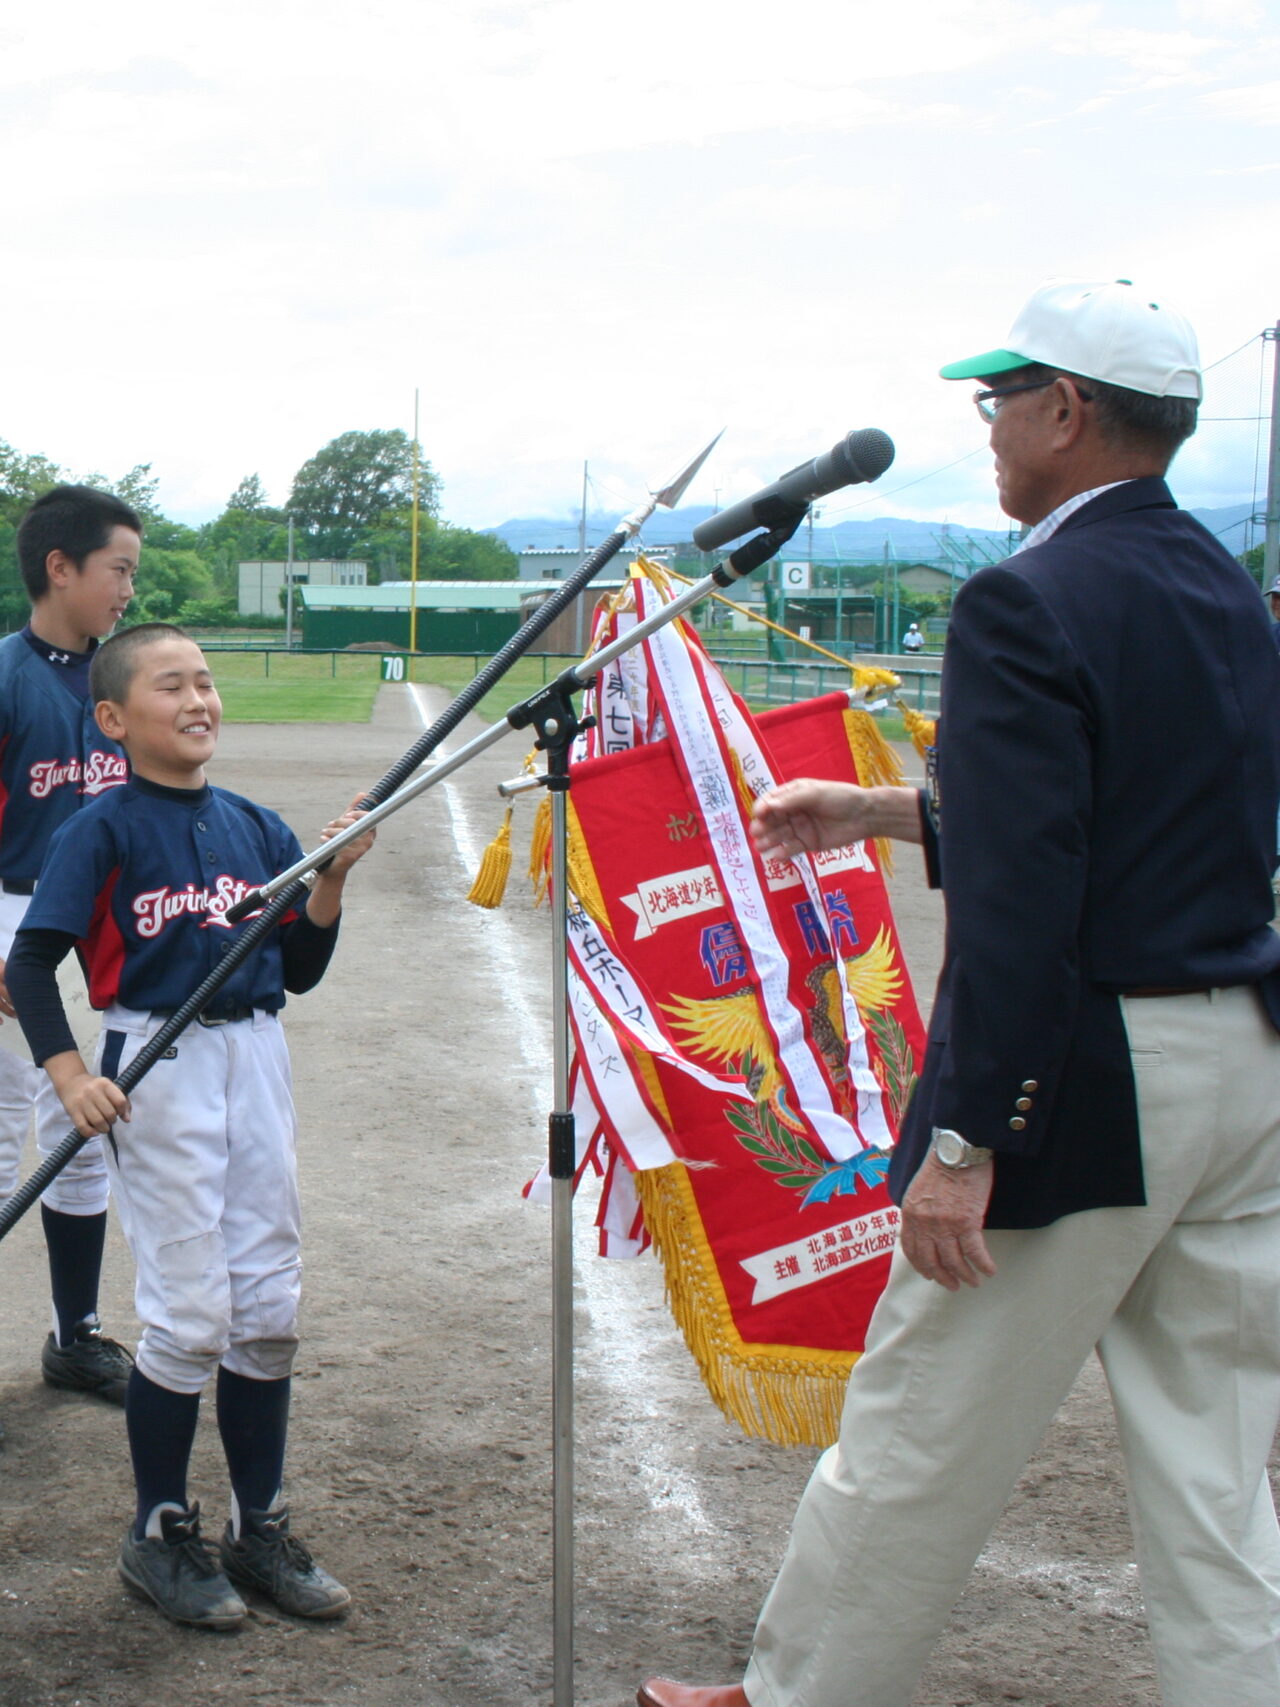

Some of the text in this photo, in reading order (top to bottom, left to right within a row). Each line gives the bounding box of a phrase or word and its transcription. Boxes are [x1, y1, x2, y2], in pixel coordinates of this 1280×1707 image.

[788, 567, 803, 584] C
[383, 656, 404, 681] 70
[84, 750, 127, 794] Sta
[132, 885, 211, 938] Twin
[773, 1254, 801, 1280] 主催
